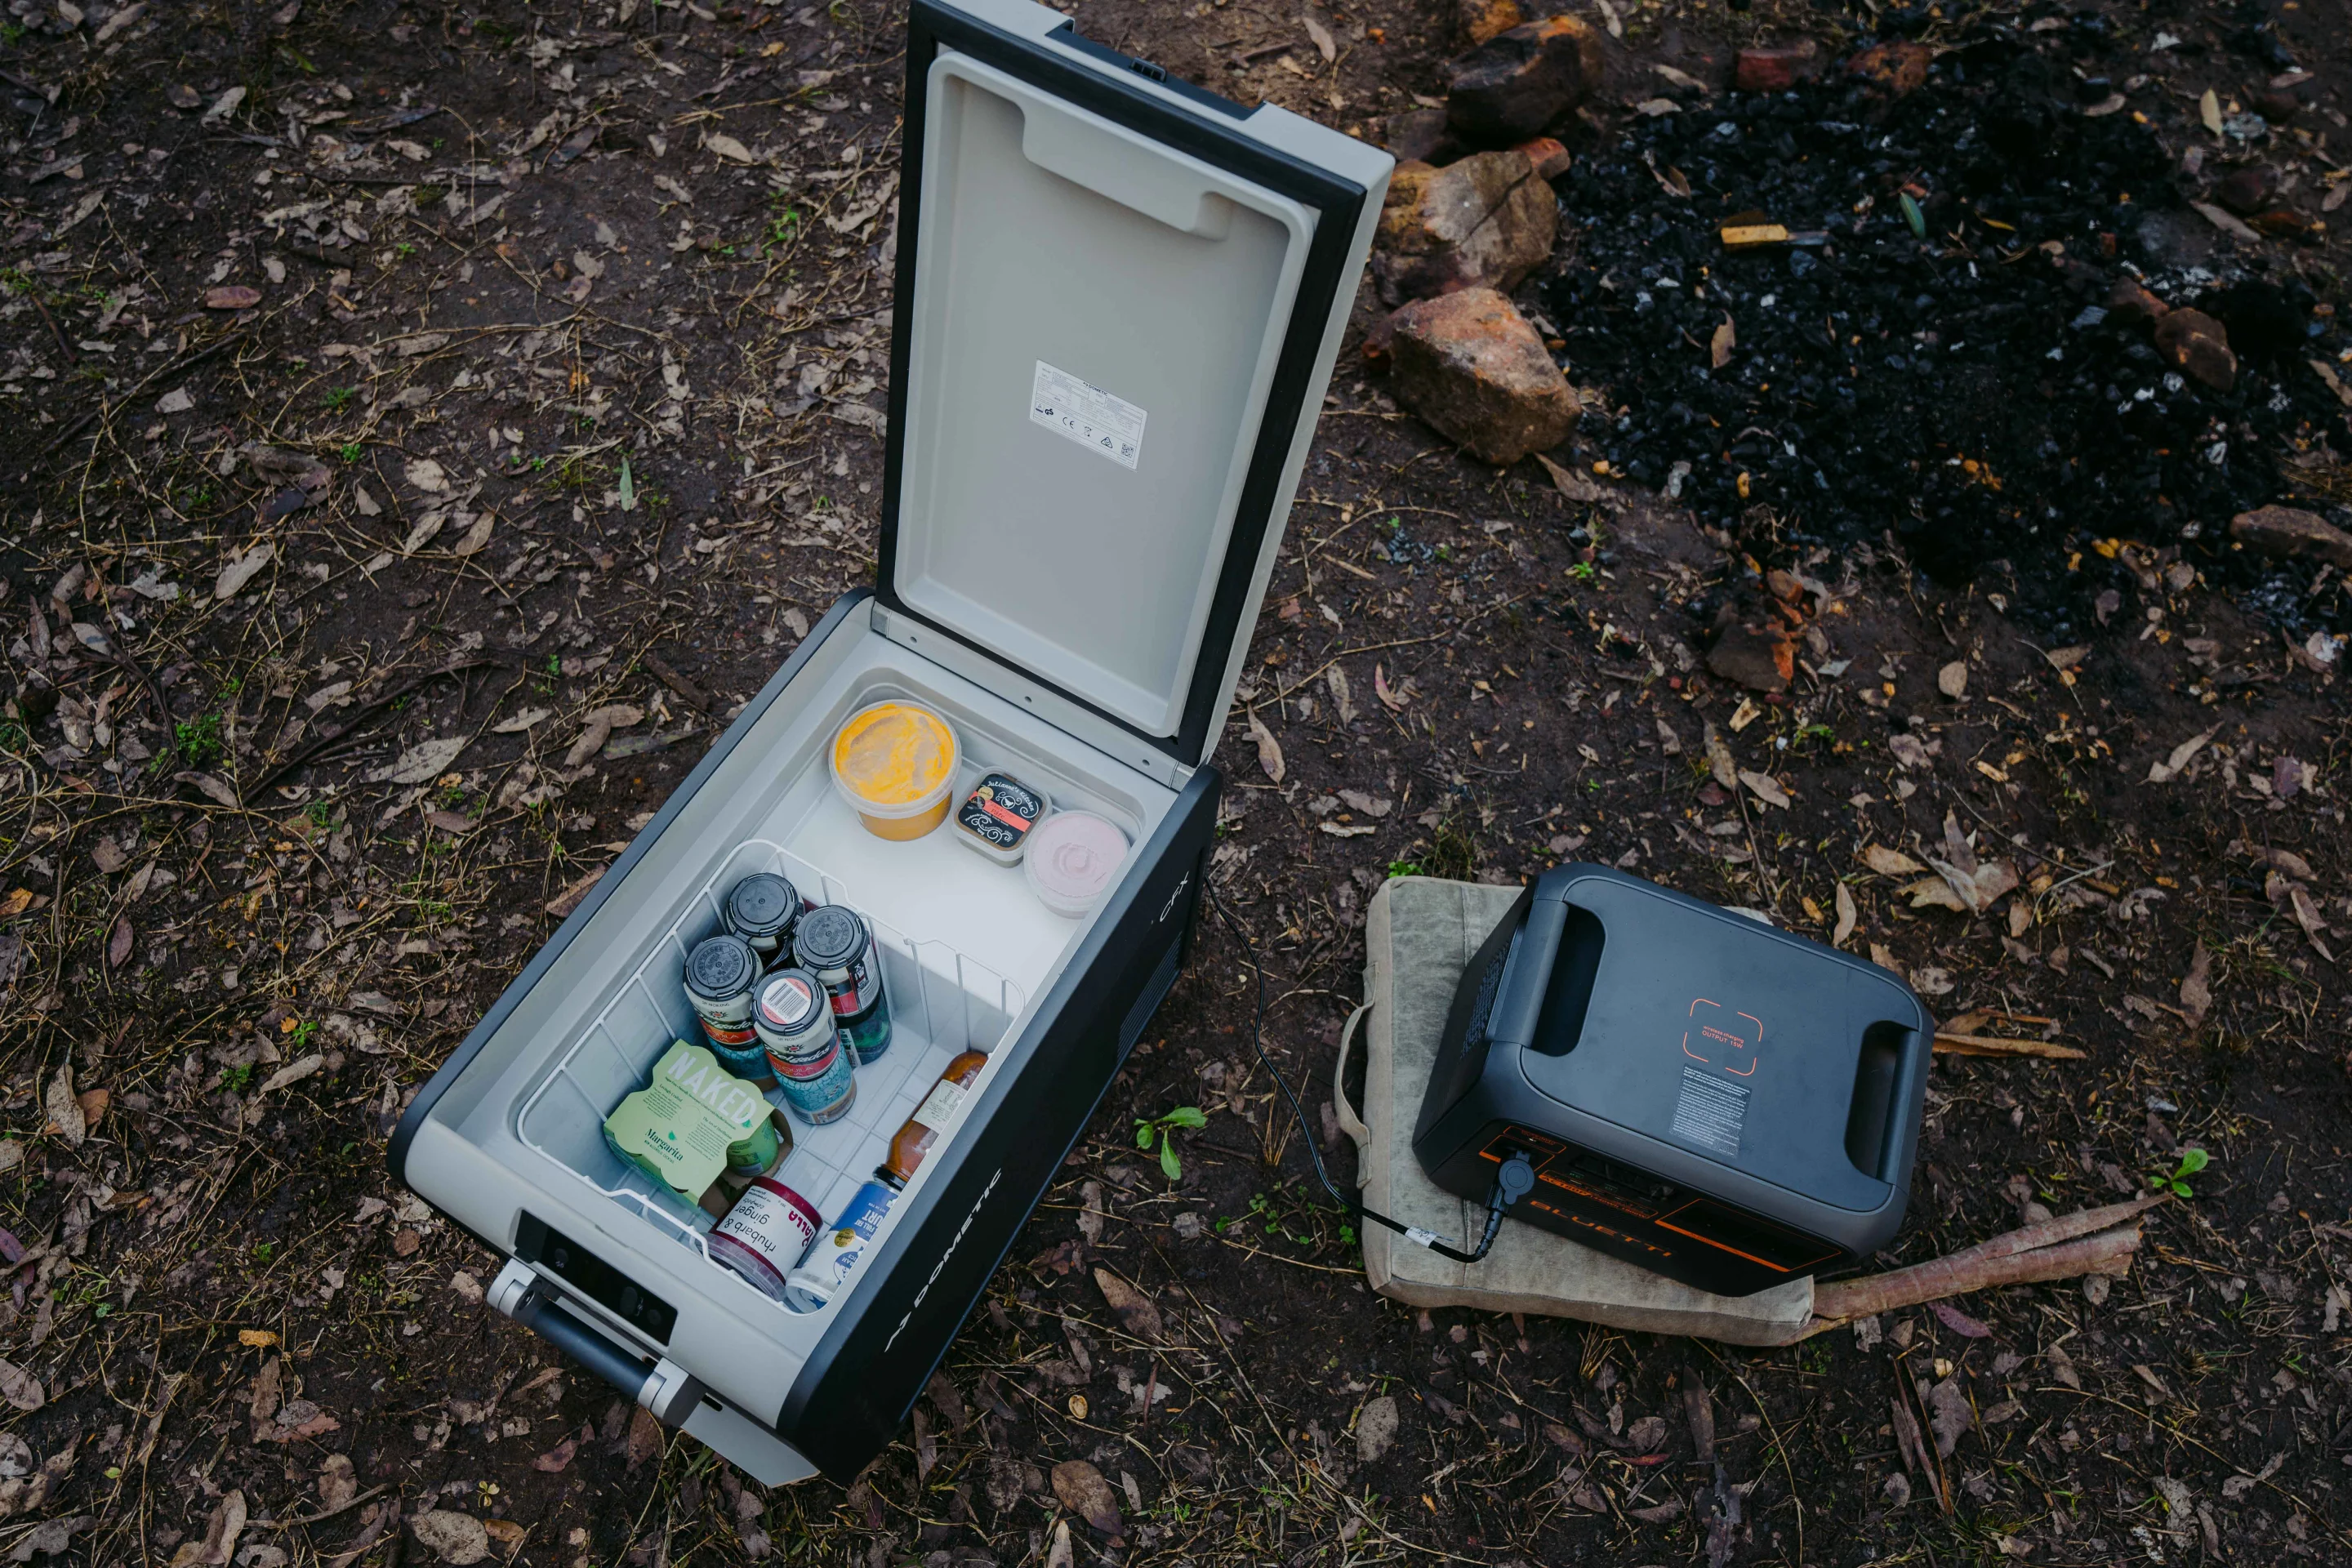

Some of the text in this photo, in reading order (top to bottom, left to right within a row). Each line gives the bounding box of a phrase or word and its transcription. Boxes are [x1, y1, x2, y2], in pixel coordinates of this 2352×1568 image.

[1089, 384, 1107, 396] DOMETIC
[987, 781, 1019, 793] Julianne's
[1019, 791, 1035, 812] Kitchen
[1702, 1030, 1744, 1049] OUTPUT 15W
[1703, 1026, 1744, 1044] wireless charging
[659, 1085, 683, 1102] Lovingly Crafted
[667, 1051, 756, 1124] NAKED
[645, 1128, 684, 1160] Margarita
[743, 1198, 765, 1209] compote
[735, 1205, 770, 1225] ginger
[862, 1209, 884, 1227] URT
[724, 1218, 777, 1253] rhubarb &
[788, 1210, 814, 1247] YALLA
[862, 1223, 875, 1232] FULL
[1530, 1200, 1673, 1257] BLUETTI
[914, 1168, 1002, 1308] DOMETIC
